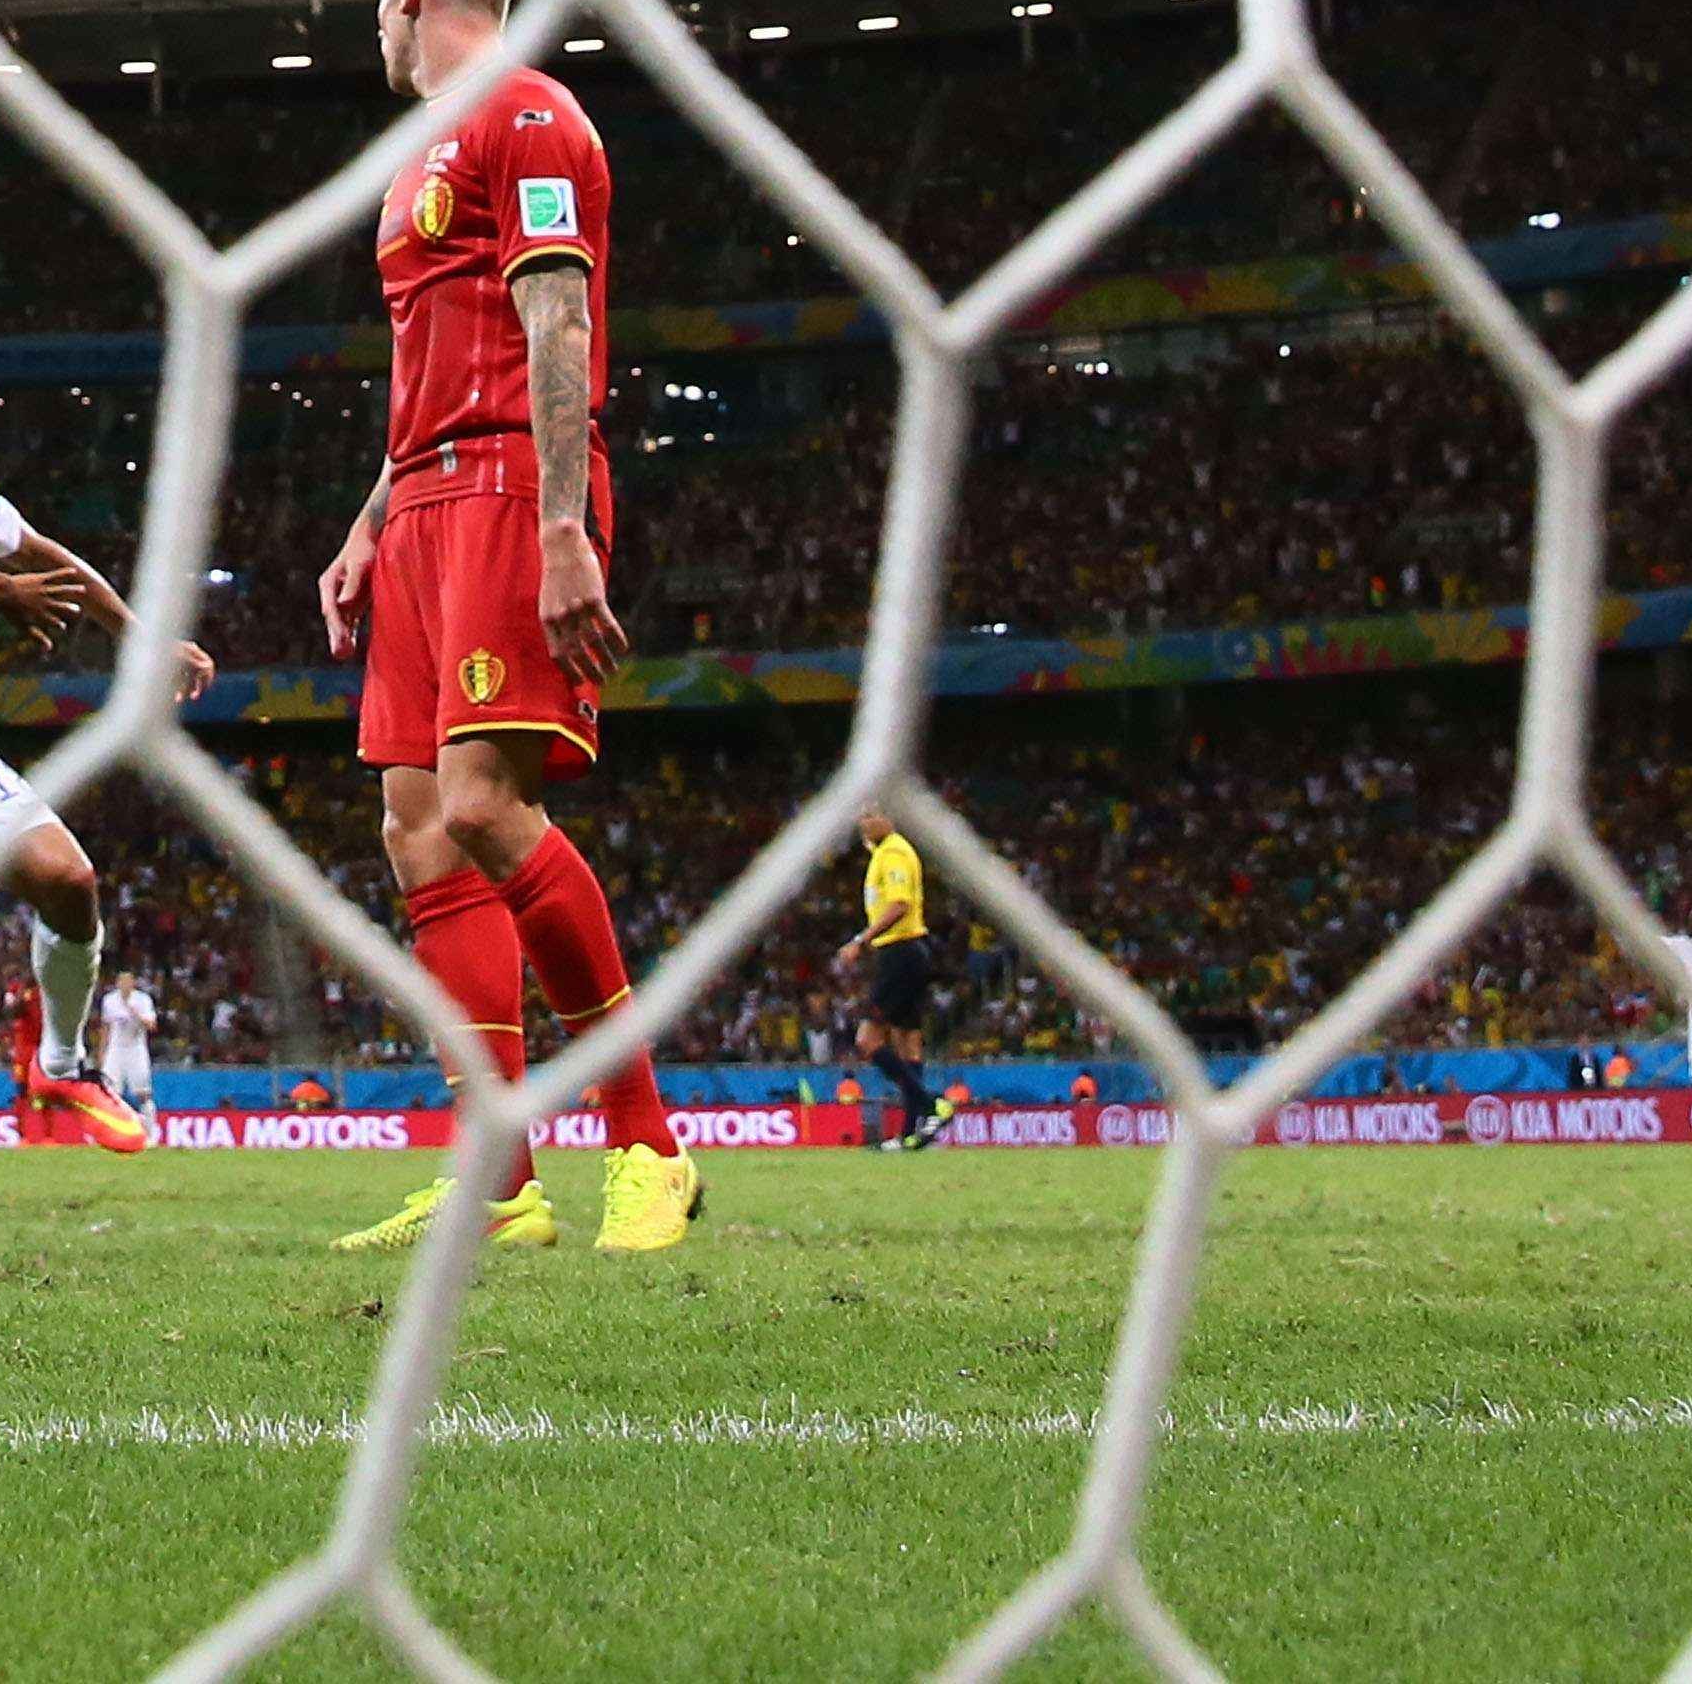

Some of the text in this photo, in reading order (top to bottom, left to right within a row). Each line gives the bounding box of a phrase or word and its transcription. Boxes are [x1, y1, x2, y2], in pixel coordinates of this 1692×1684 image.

[166, 1113, 407, 1148] KIA MOTORS
[666, 1109, 797, 1146] OTORS
[1511, 1099, 1554, 1140] KIA
[1557, 1096, 1664, 1142] MOTORS
